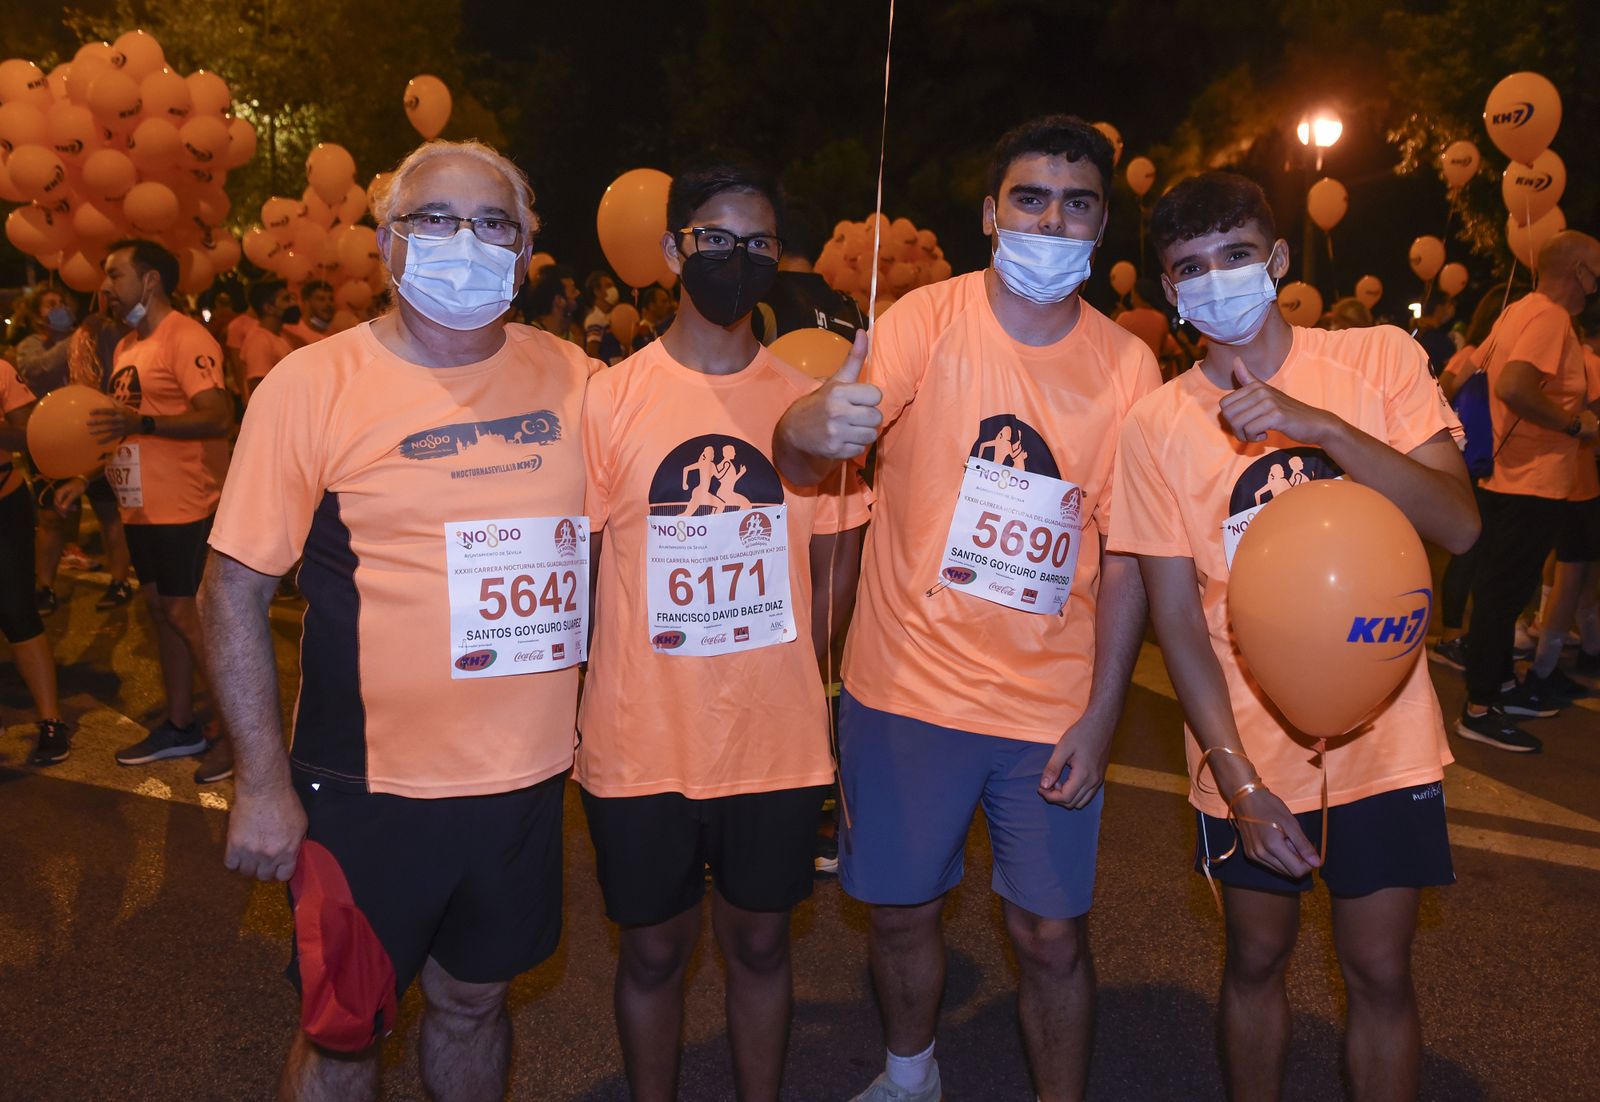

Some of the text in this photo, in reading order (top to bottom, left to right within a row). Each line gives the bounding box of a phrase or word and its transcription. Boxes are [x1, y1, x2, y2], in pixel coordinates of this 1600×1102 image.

[972, 511, 1070, 568] 5690
[474, 565, 502, 574] CARRERA
[504, 563, 535, 571] NOCTURNA
[669, 558, 766, 606] 6171
[951, 547, 987, 565] SANTOS
[990, 558, 1036, 580] GOYGURO
[1040, 572, 1070, 585] BARROSO
[479, 570, 576, 620] 5642
[657, 612, 710, 622] FRANCISCO
[712, 608, 739, 620] DAVID
[741, 604, 763, 616] BAEZ
[765, 600, 783, 612] DIAZ
[467, 618, 581, 641] SANTOS GOYGURO SUAREZ
